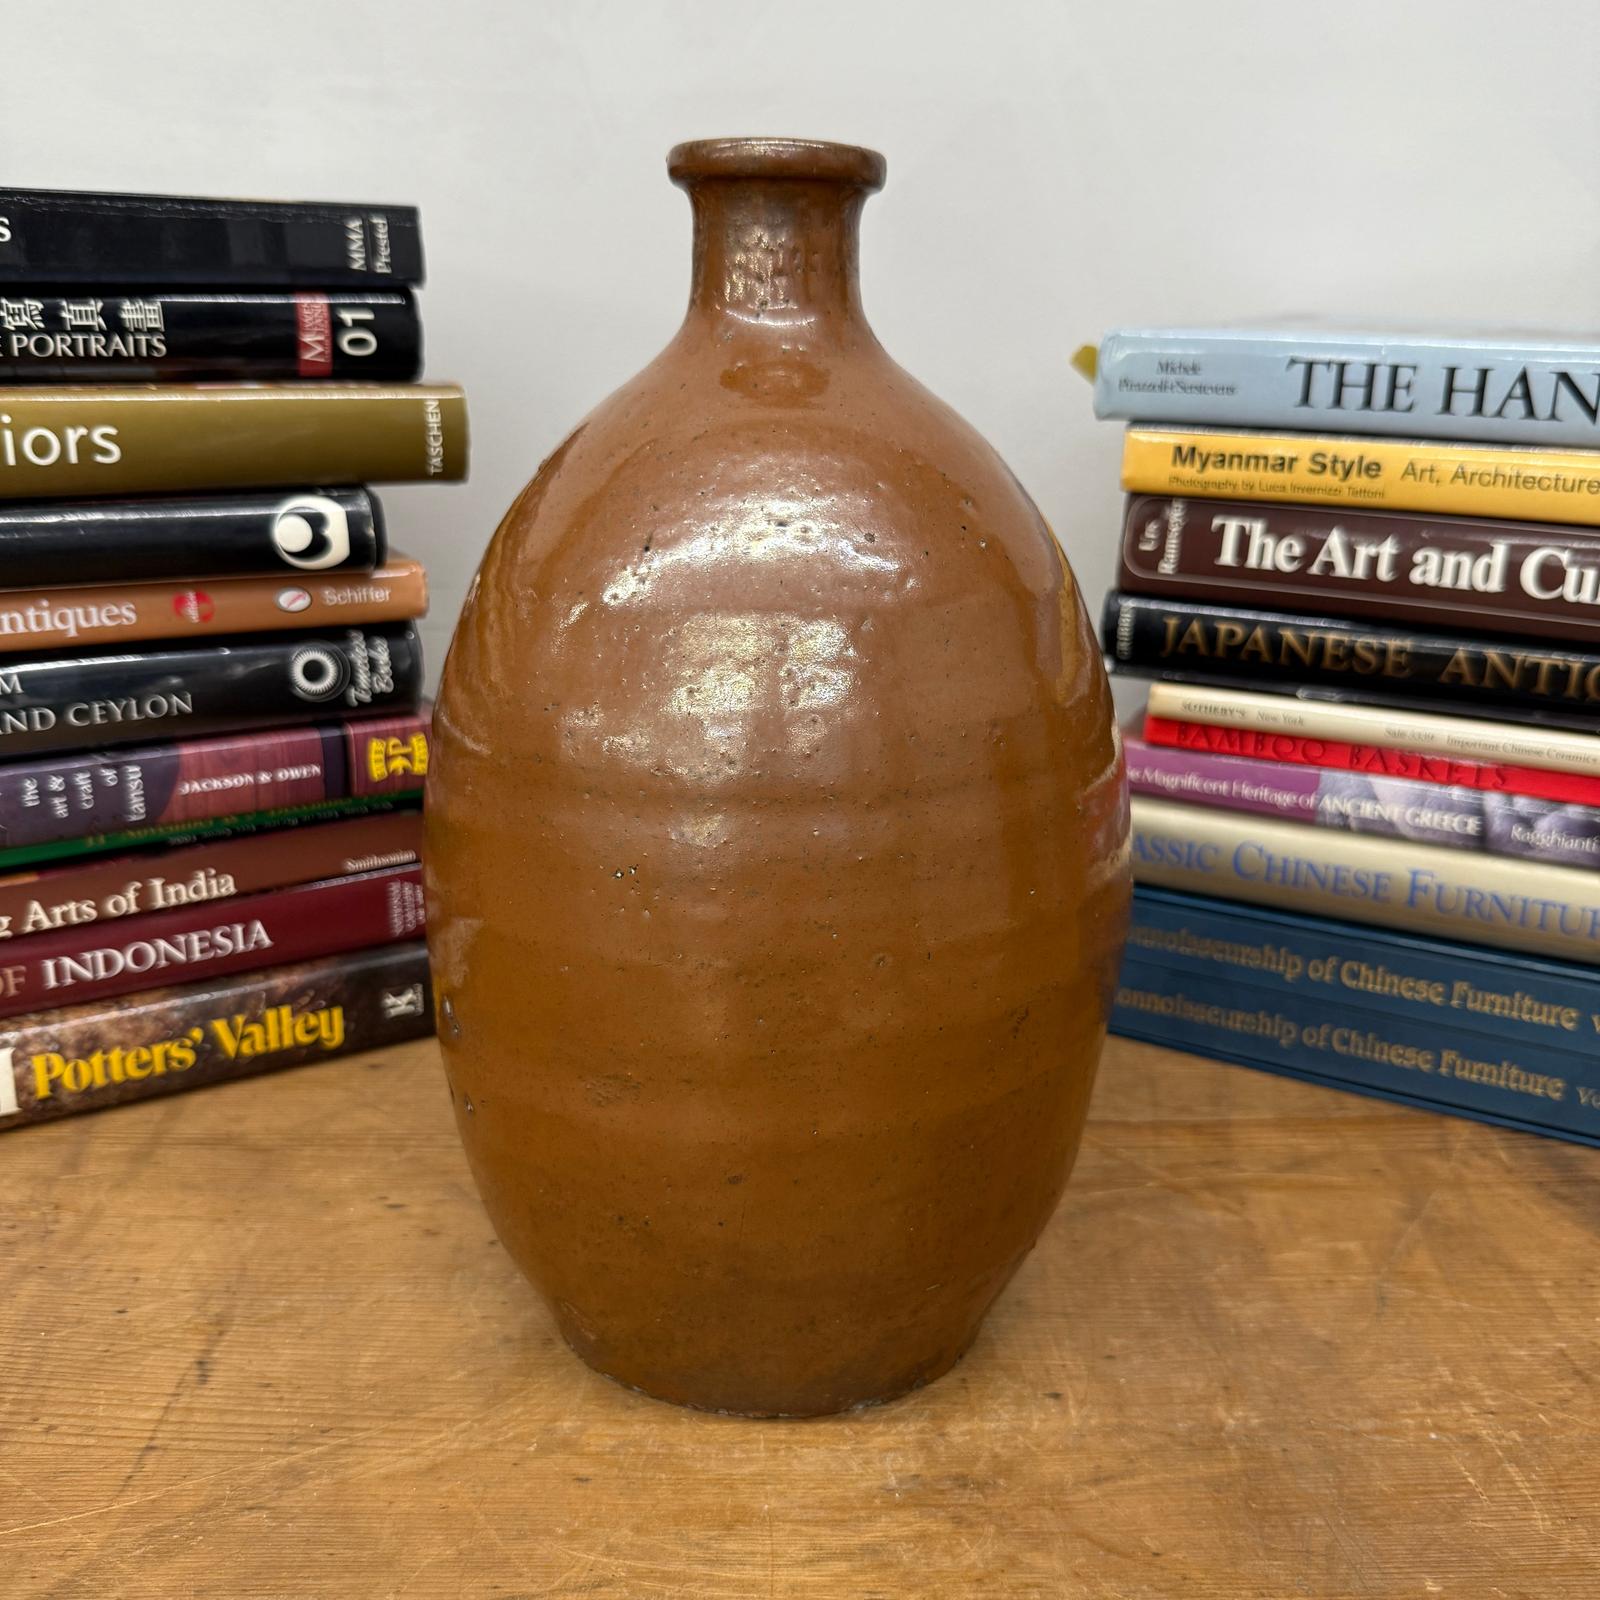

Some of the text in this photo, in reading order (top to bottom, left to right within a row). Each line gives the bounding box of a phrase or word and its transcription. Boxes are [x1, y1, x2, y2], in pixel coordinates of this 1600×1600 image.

[11, 332, 167, 358] PORTRAITS
[337, 307, 378, 357] 01
[1287, 357, 1600, 425] THE HAN
[0, 415, 122, 467] iors
[425, 399, 444, 475] TASCHEN
[1168, 475, 1238, 492] Photography
[1241, 480, 1255, 492] by
[1258, 480, 1287, 493] Luca
[1171, 446, 1600, 496] Myanmar Style Art, Architecture
[1211, 515, 1303, 573] The
[1308, 526, 1400, 582] Art
[1408, 543, 1507, 594] and
[0, 599, 138, 637] ntiques
[321, 584, 393, 607] Schiffer
[1161, 616, 1413, 679] JAPANESE
[65, 690, 193, 728] CEYLON
[1255, 709, 1278, 723] New
[1281, 713, 1305, 727] York
[1446, 735, 1500, 753] Important
[101, 767, 119, 787] of
[178, 763, 322, 796] JACKSON & OWEN
[1176, 722, 1507, 789] BAMBOO BASKETS
[22, 776, 41, 808] the
[48, 774, 69, 819] art &
[74, 770, 95, 810] craft
[123, 764, 147, 822] tansu
[1142, 767, 1229, 793] Magnificent
[1231, 780, 1298, 809] Heritage
[1298, 792, 1318, 809] of
[1317, 794, 1400, 827] ANCIENT
[1405, 806, 1483, 837] GREECE
[1231, 840, 1391, 902] CHINESE
[23, 899, 99, 934] Arts
[100, 880, 143, 918] of
[149, 866, 238, 903] India
[40, 918, 274, 990] INDONESIA
[1307, 954, 1339, 983] of
[1340, 961, 1446, 1004] Chinese
[1452, 980, 1580, 1031] Furniture
[31, 1027, 204, 1100] Potters'
[212, 1004, 345, 1062] Valley
[1302, 1023, 1332, 1050] of
[1332, 1027, 1437, 1072] Chinese
[1438, 1048, 1567, 1100] Furniture
